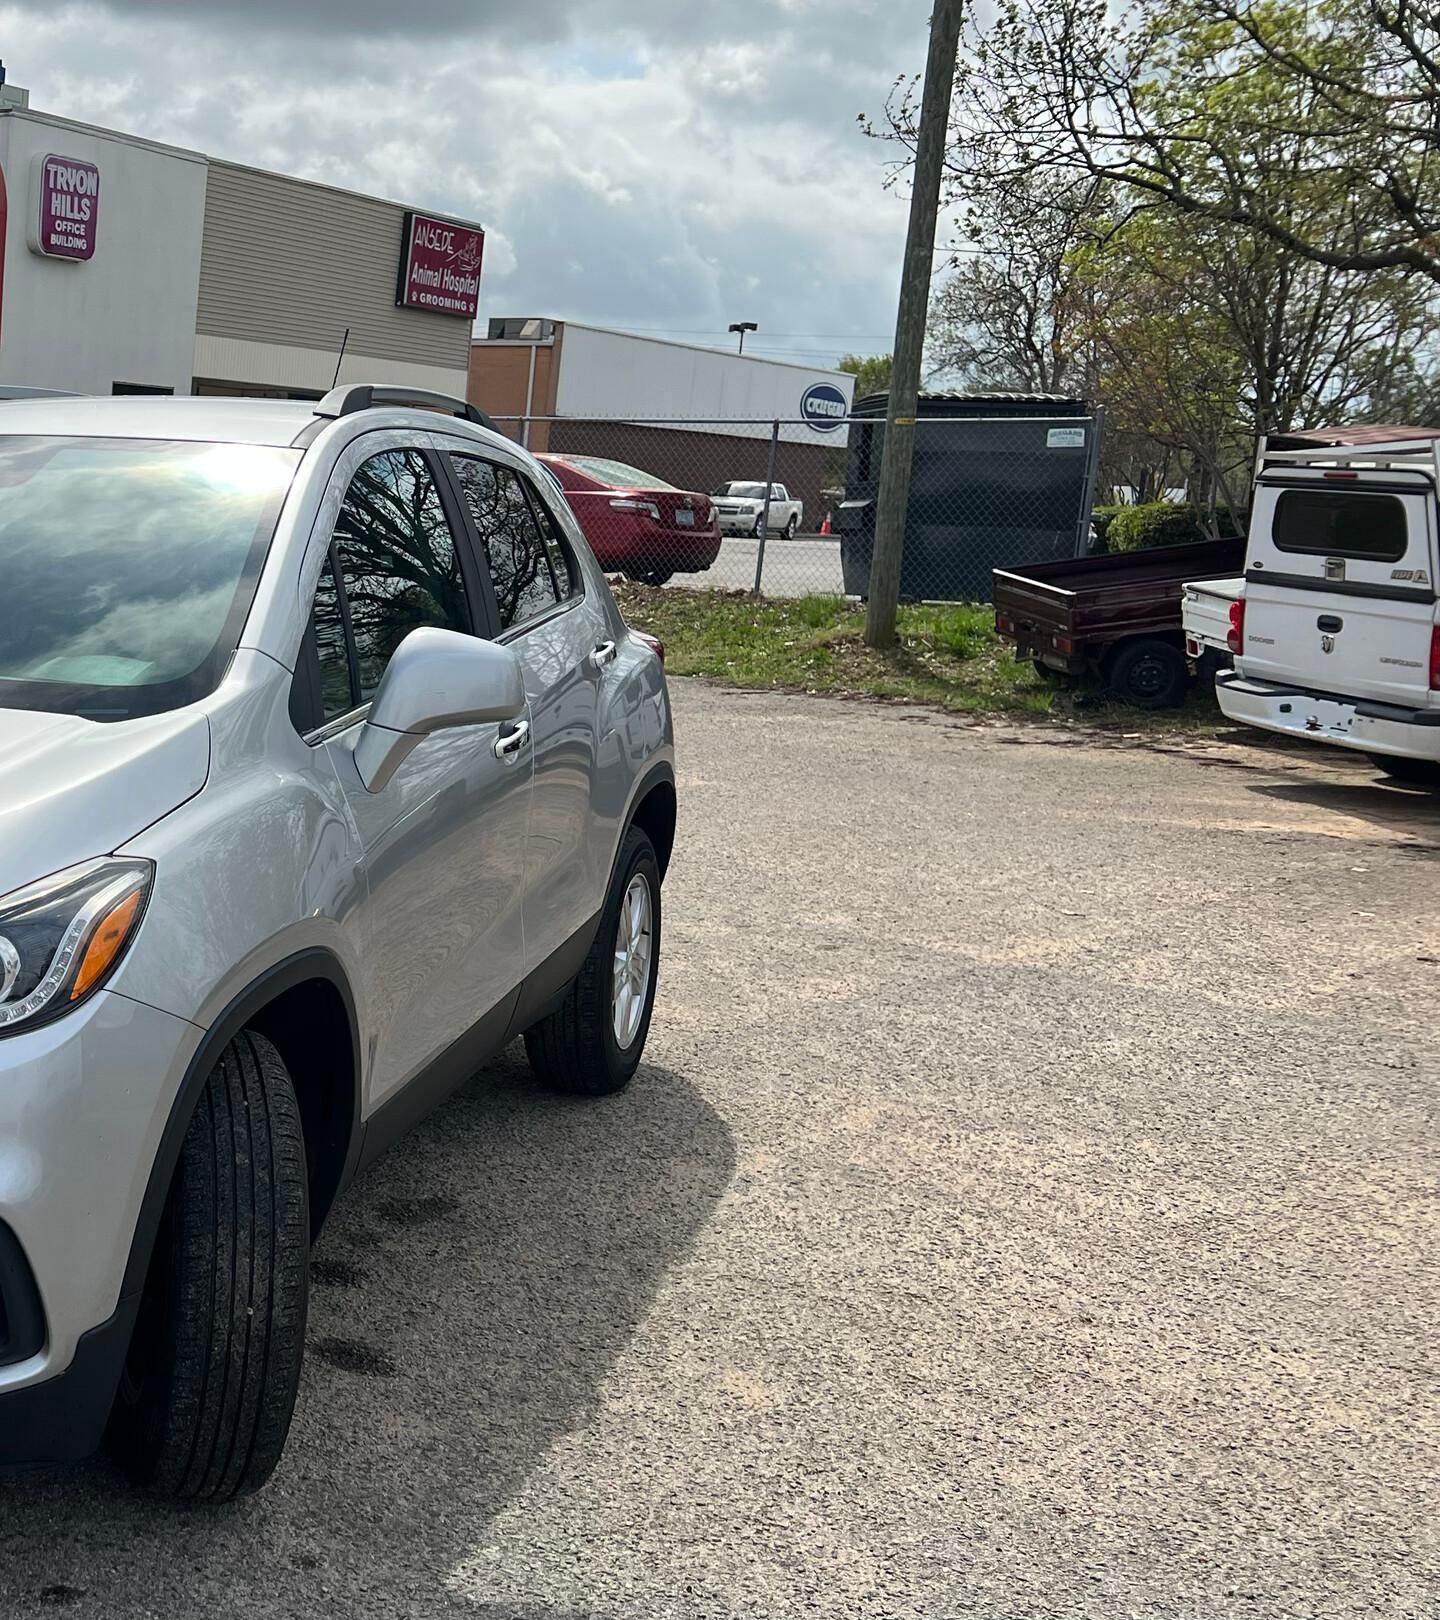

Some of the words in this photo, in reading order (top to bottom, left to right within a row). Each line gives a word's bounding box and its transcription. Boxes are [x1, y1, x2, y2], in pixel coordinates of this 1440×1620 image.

[47, 163, 98, 196] TRYON
[51, 192, 91, 221] HILLS
[55, 220, 86, 236] OFFICE
[50, 233, 87, 250] BUILDING
[411, 261, 443, 288] Animal
[442, 268, 480, 298] Hospital
[419, 292, 467, 311] GROOMING
